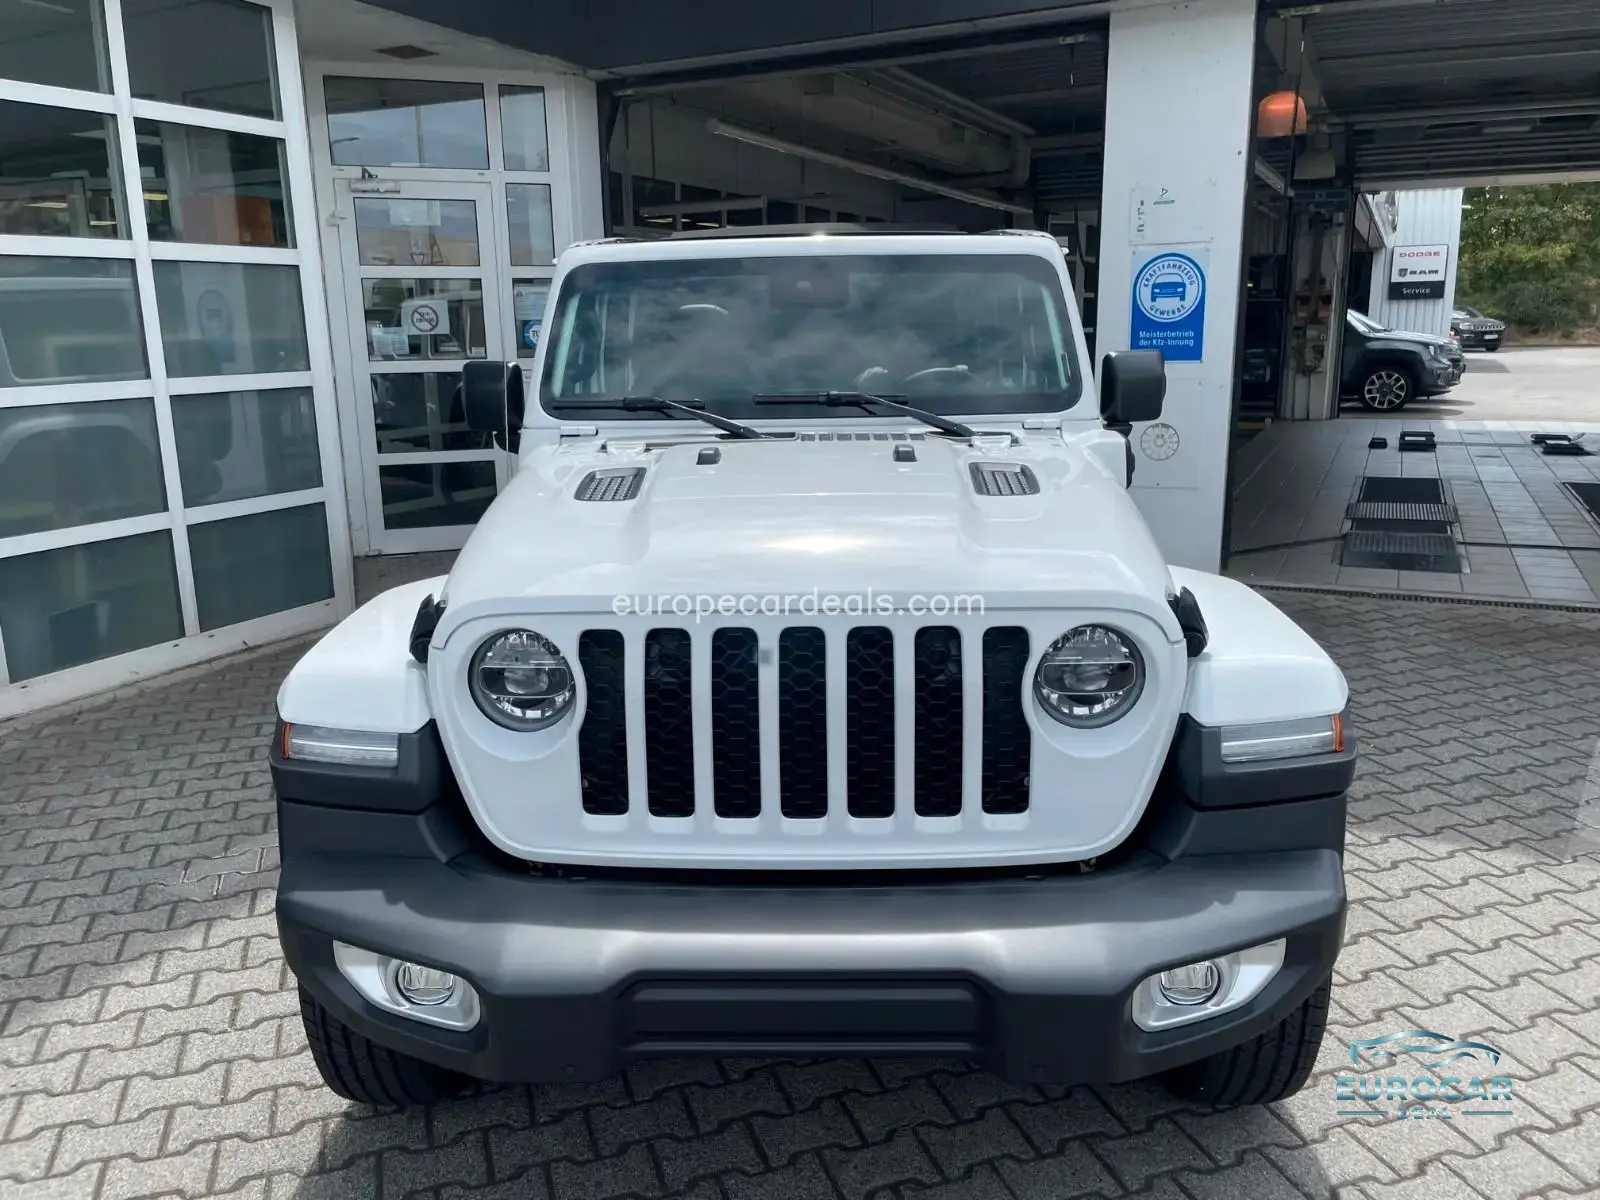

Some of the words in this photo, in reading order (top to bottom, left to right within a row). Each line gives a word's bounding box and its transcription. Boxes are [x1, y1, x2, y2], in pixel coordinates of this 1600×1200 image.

[1143, 262, 1196, 287] KRAFTFAHRZEUG
[1149, 304, 1187, 317] GEWERBE
[1139, 330, 1195, 339] Meisterbetrieb
[1139, 339, 1151, 347] der
[1152, 338, 1194, 347] Kfz-Innung
